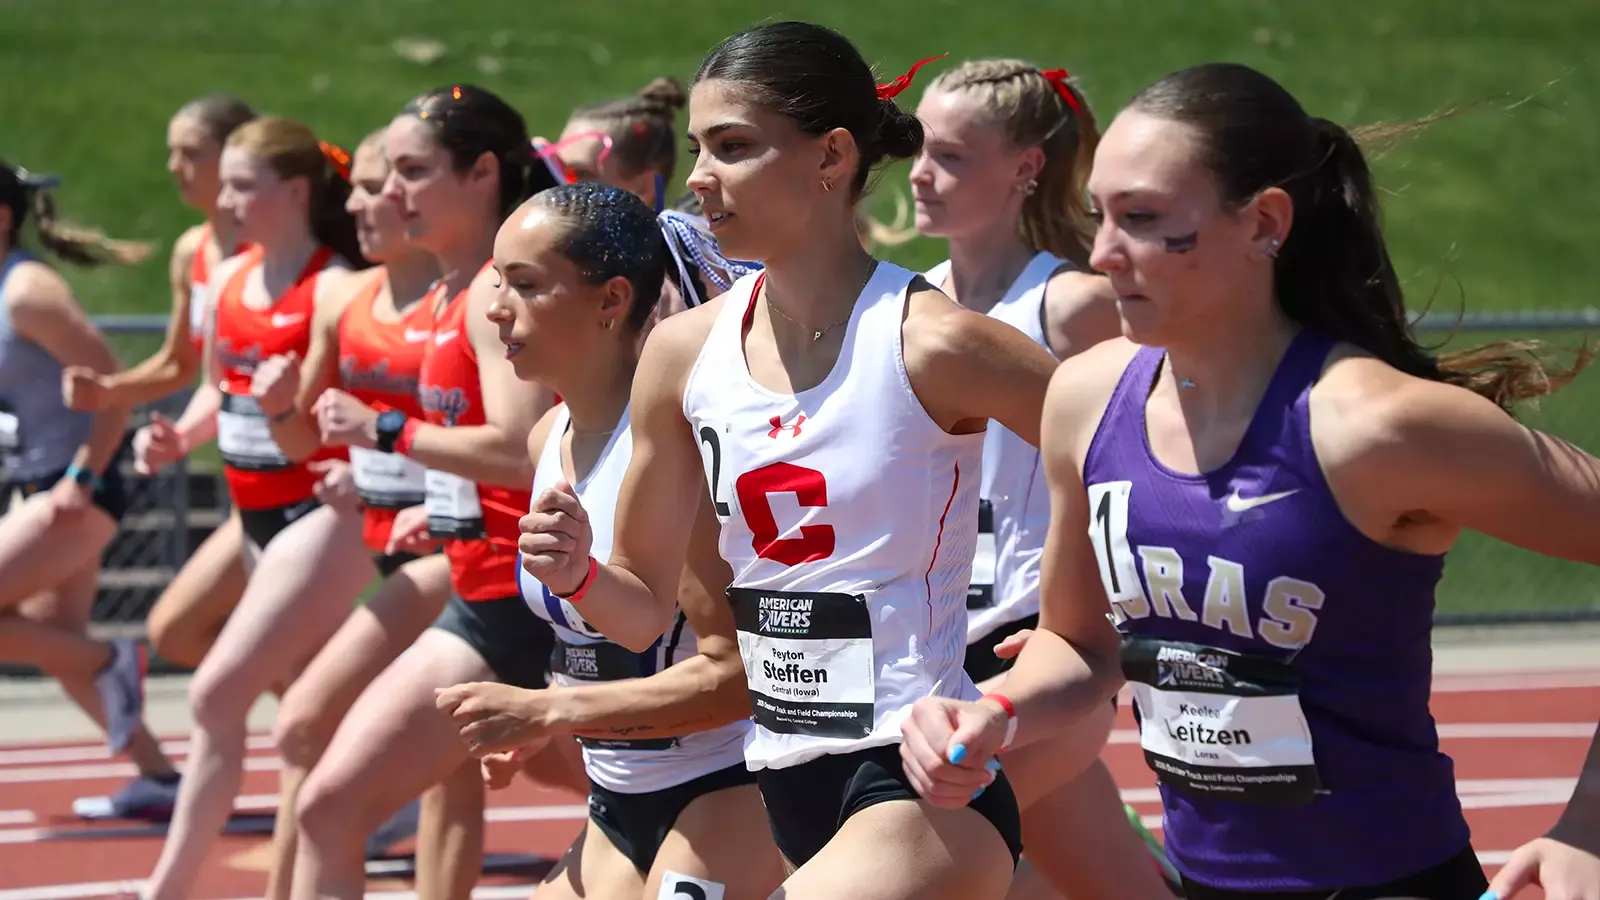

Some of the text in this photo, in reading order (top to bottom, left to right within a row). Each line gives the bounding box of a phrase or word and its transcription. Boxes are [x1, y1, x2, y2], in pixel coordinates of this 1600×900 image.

[700, 427, 731, 517] 2
[736, 461, 836, 567] C
[1096, 490, 1121, 594] 1
[759, 597, 813, 611] AMERICAN
[1112, 545, 1326, 650] RAS
[772, 648, 804, 661] Peyton
[1156, 646, 1229, 667] AMERICAN
[763, 660, 828, 683] Steffen
[771, 684, 820, 697] Central (Iowa)
[797, 709, 811, 717] Field
[811, 709, 858, 719] Championships
[1179, 704, 1220, 719] Keelee
[1164, 717, 1252, 745] Leitzen
[1194, 750, 1220, 760] Loras
